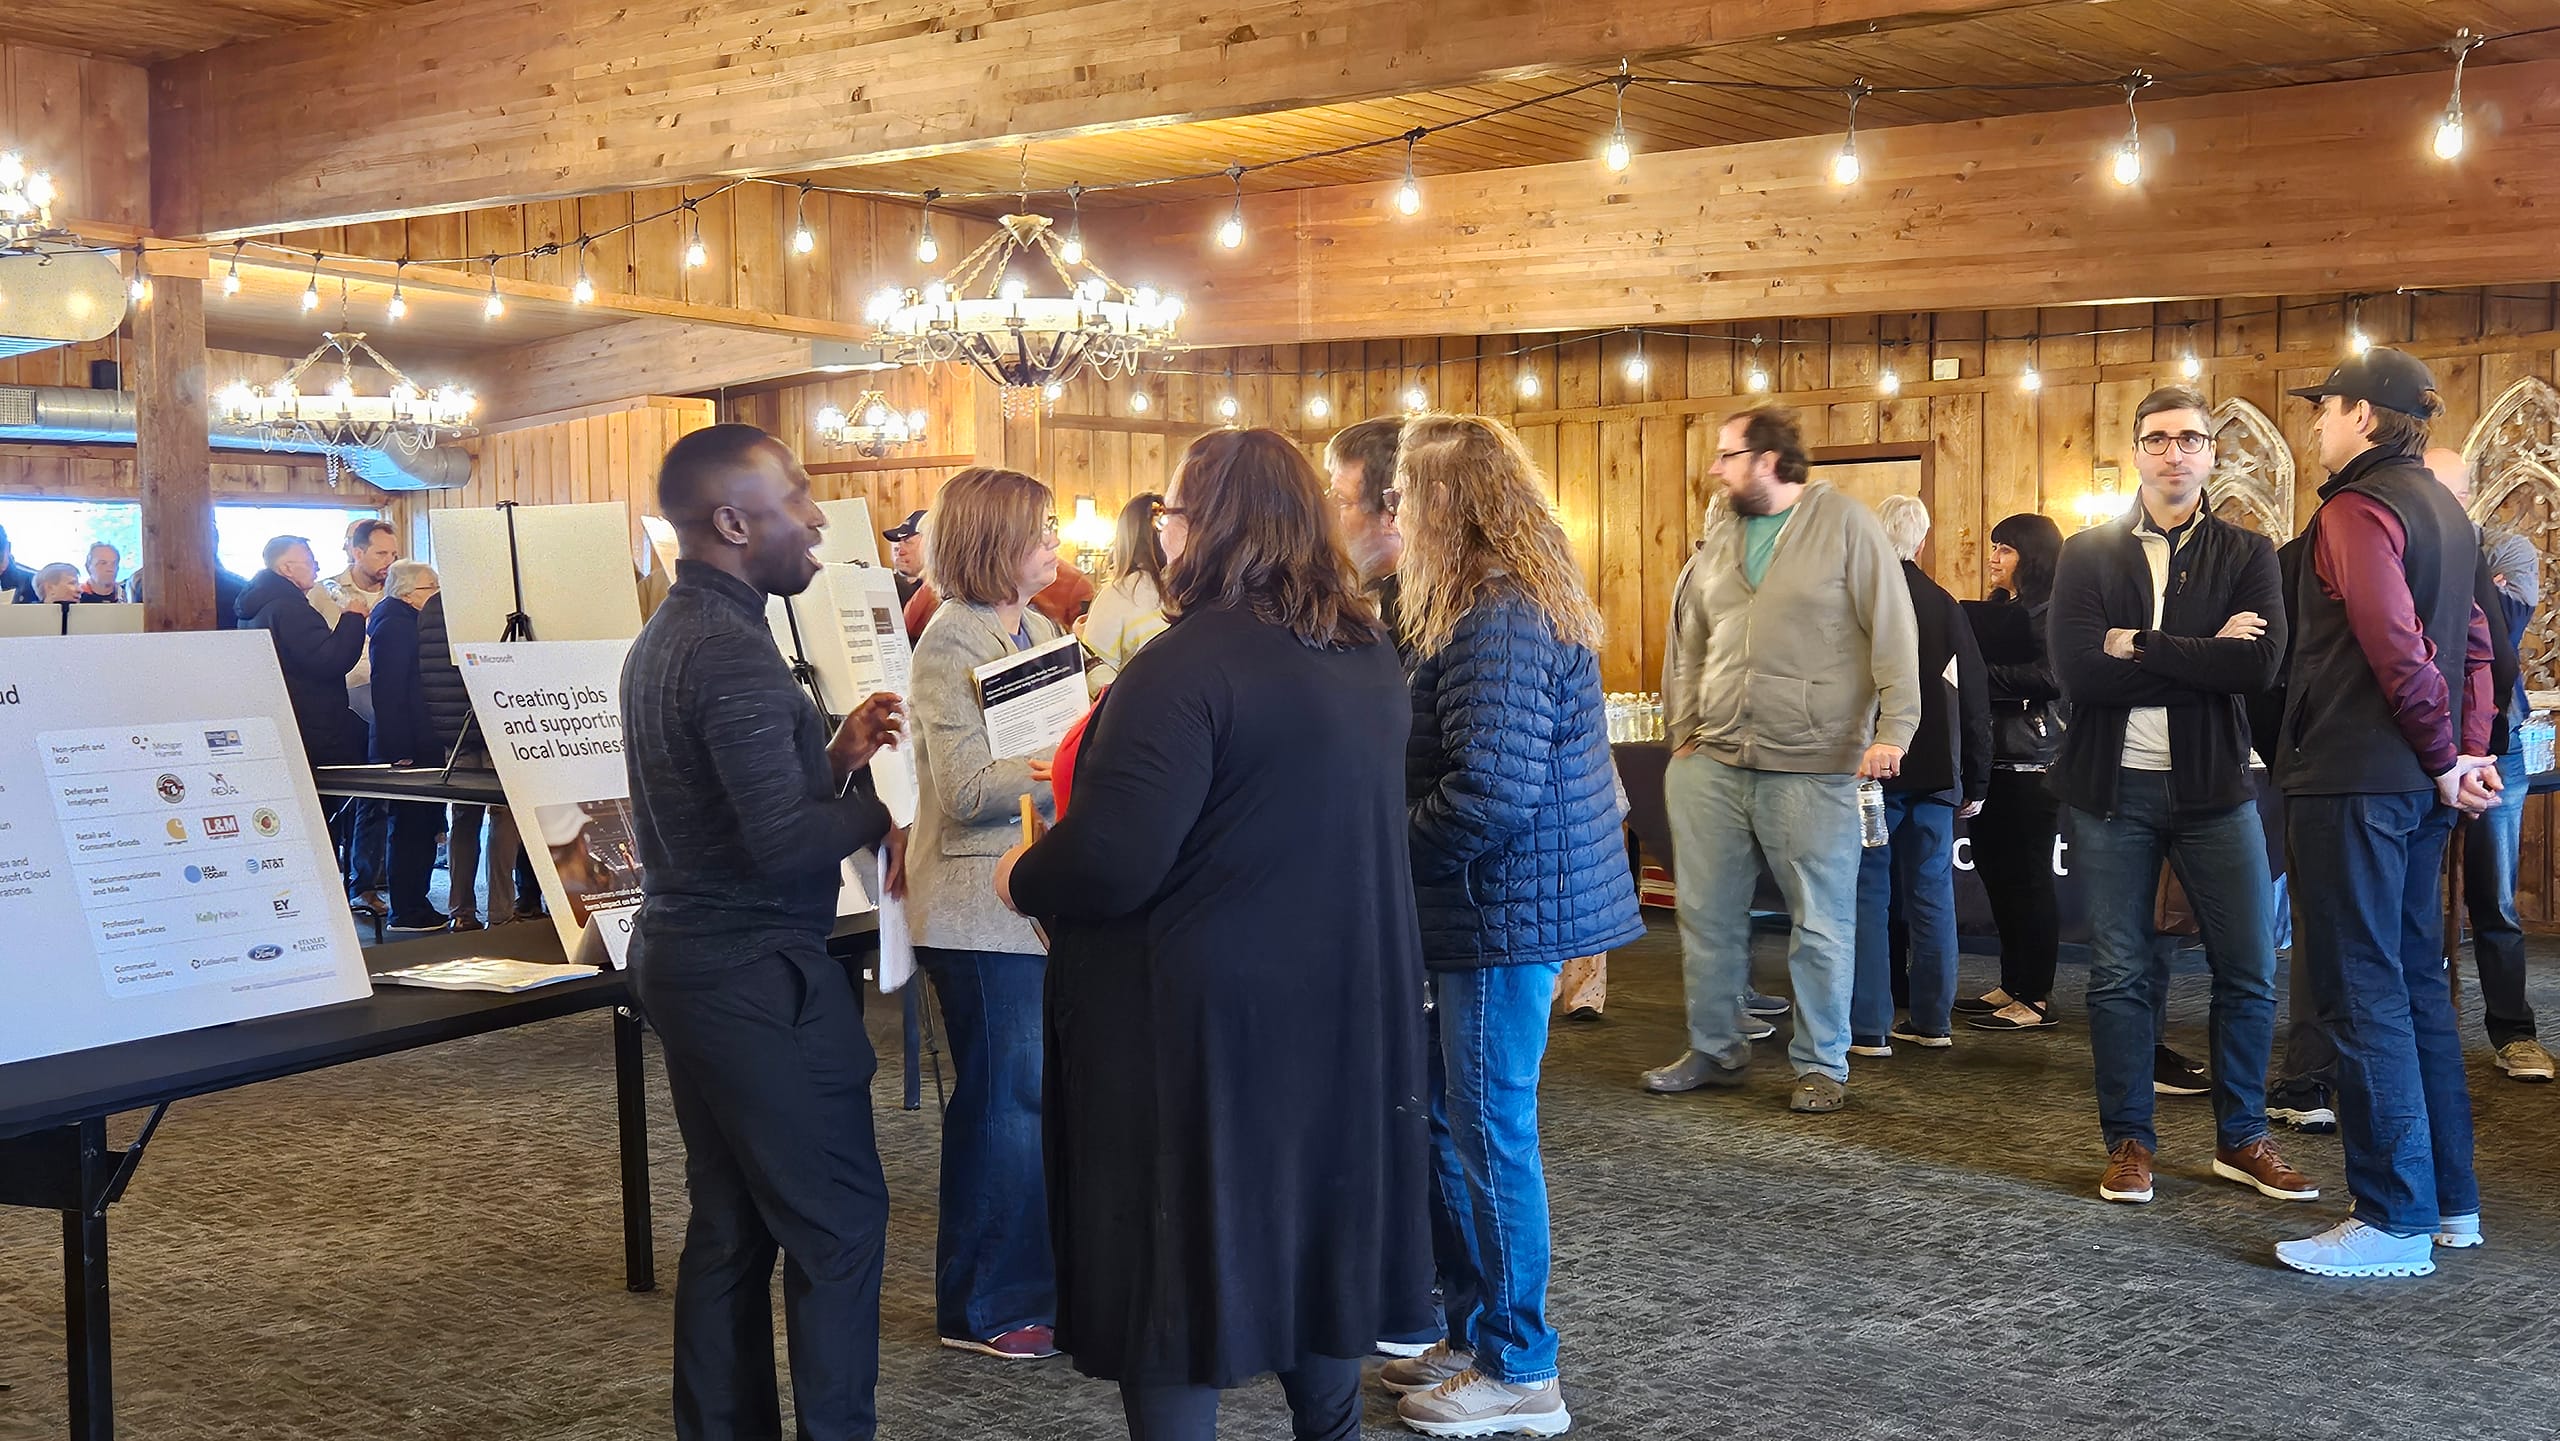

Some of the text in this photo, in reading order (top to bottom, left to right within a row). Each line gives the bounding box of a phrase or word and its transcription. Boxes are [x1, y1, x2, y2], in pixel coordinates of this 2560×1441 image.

[479, 654, 515, 664] Microsoft
[493, 686, 608, 711] Creating jobs
[503, 710, 622, 736] and supportin
[51, 743, 105, 754] Non-profit and
[510, 737, 625, 761] local business
[64, 785, 109, 796] Defense and
[67, 796, 109, 807] Intelligence
[205, 816, 238, 834] L&M
[75, 830, 111, 841] Retail and
[79, 839, 141, 852] Consumer Goods
[11, 857, 29, 867] and
[261, 858, 285, 870] AT&T
[201, 865, 217, 874] USA
[203, 871, 228, 880] TODAY
[0, 869, 51, 884] osoft Cloud
[89, 870, 161, 886] Telecommunications
[93, 885, 130, 896] and Media
[273, 899, 291, 912] EY
[102, 916, 145, 929] Professional
[195, 910, 219, 923] Kelly
[105, 925, 167, 940] Business Services
[113, 960, 157, 974] Commercial
[117, 969, 174, 985] Other Industries
